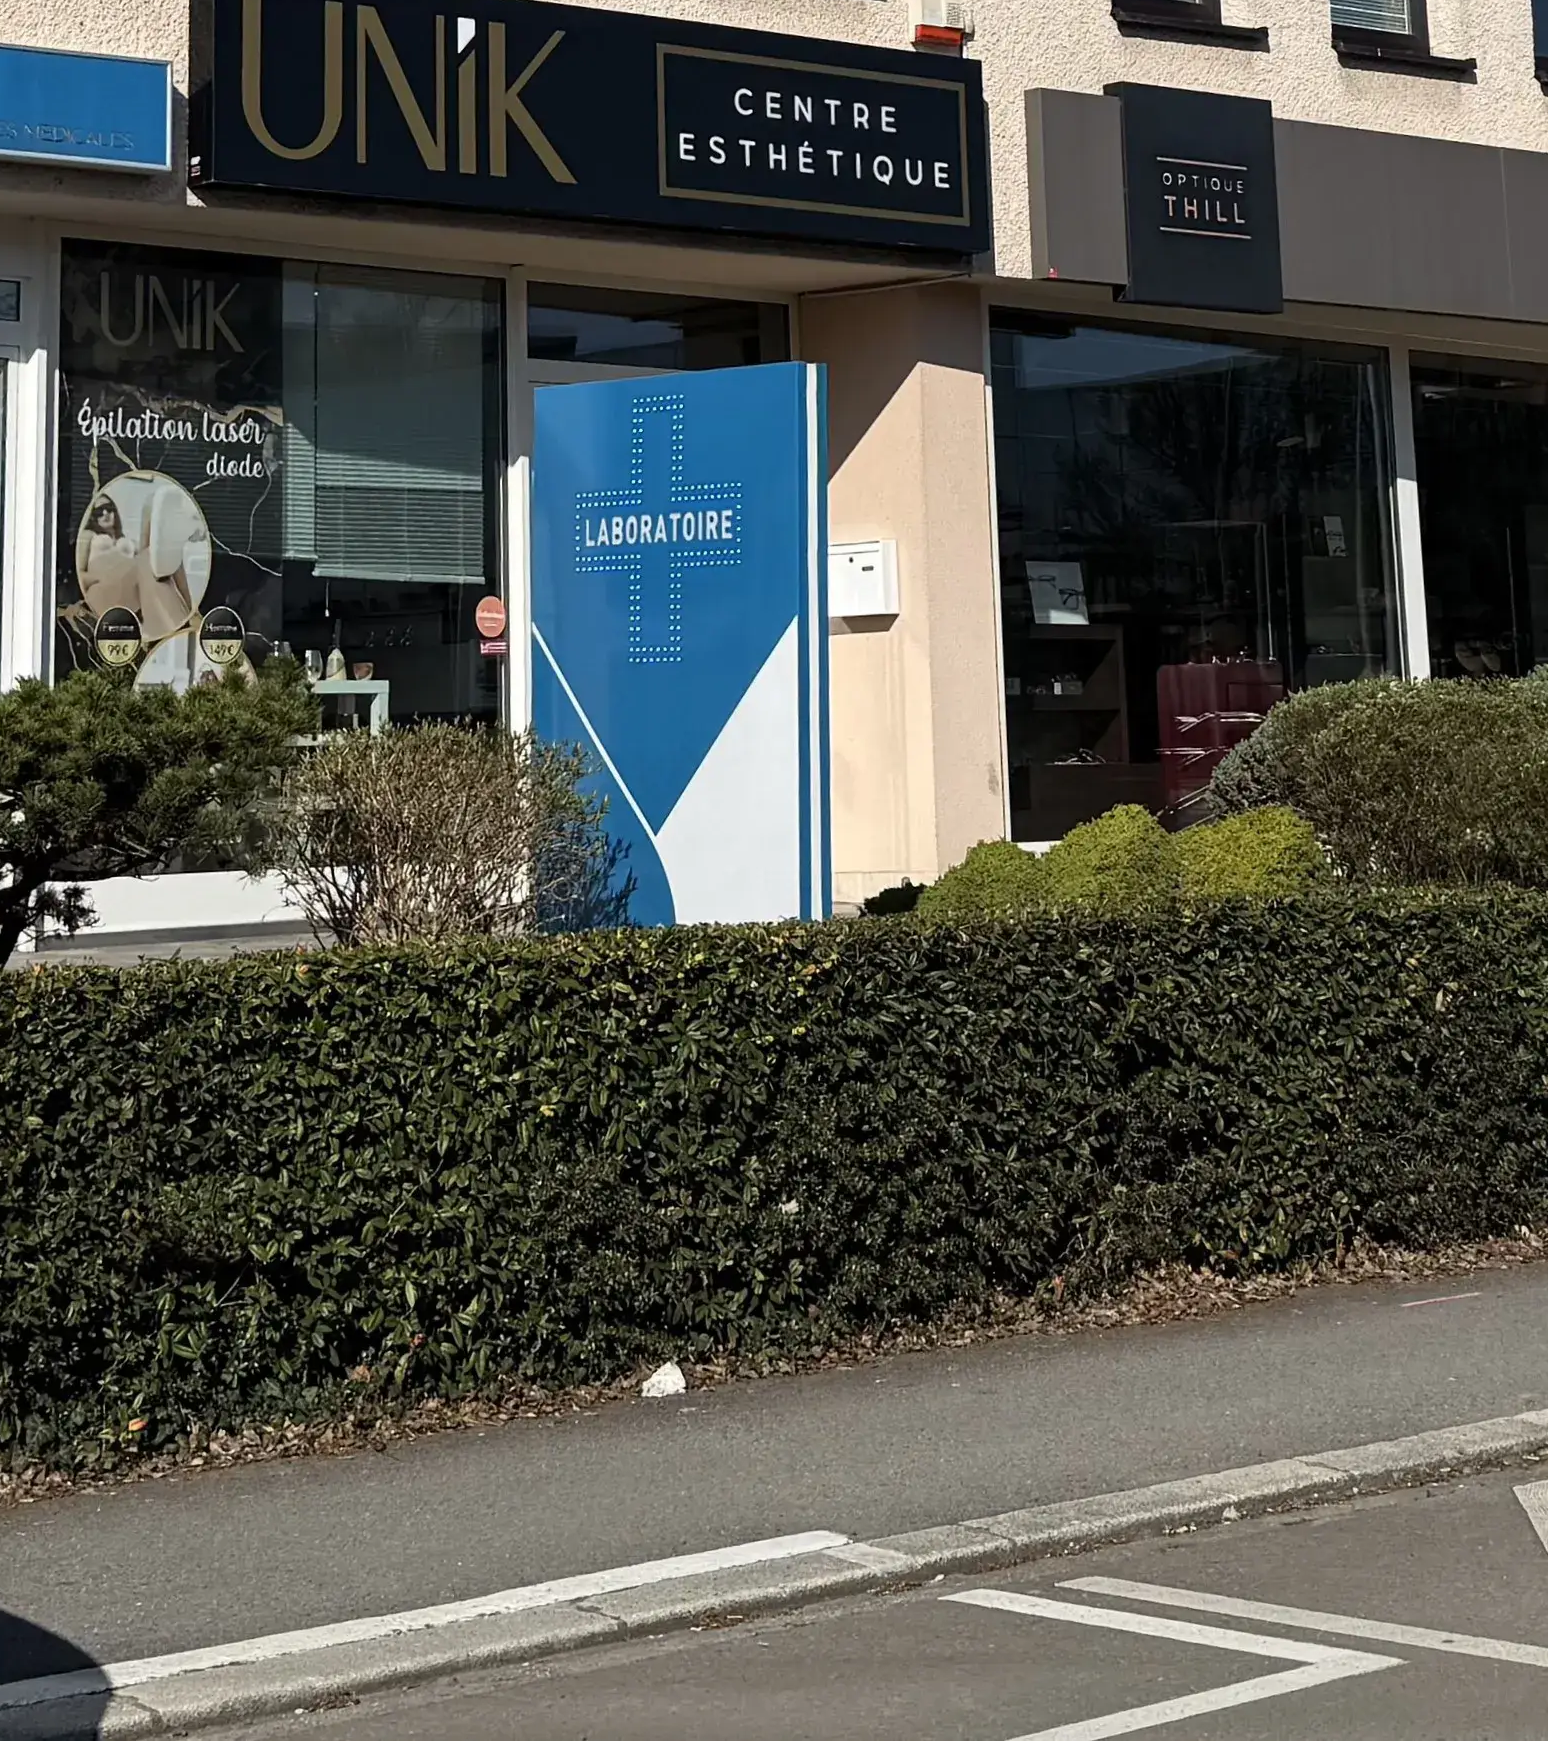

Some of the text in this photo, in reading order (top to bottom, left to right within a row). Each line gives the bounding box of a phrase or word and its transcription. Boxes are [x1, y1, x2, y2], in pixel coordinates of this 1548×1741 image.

[733, 87, 899, 134] CENTRE
[678, 131, 952, 190] ESTHÉTIQUE
[1162, 172, 1245, 194] OPTIQUE
[1163, 195, 1246, 224] THILL
[77, 397, 265, 447] Épilation laser
[206, 454, 264, 479] diode
[585, 509, 733, 547] LABORATOIRE
